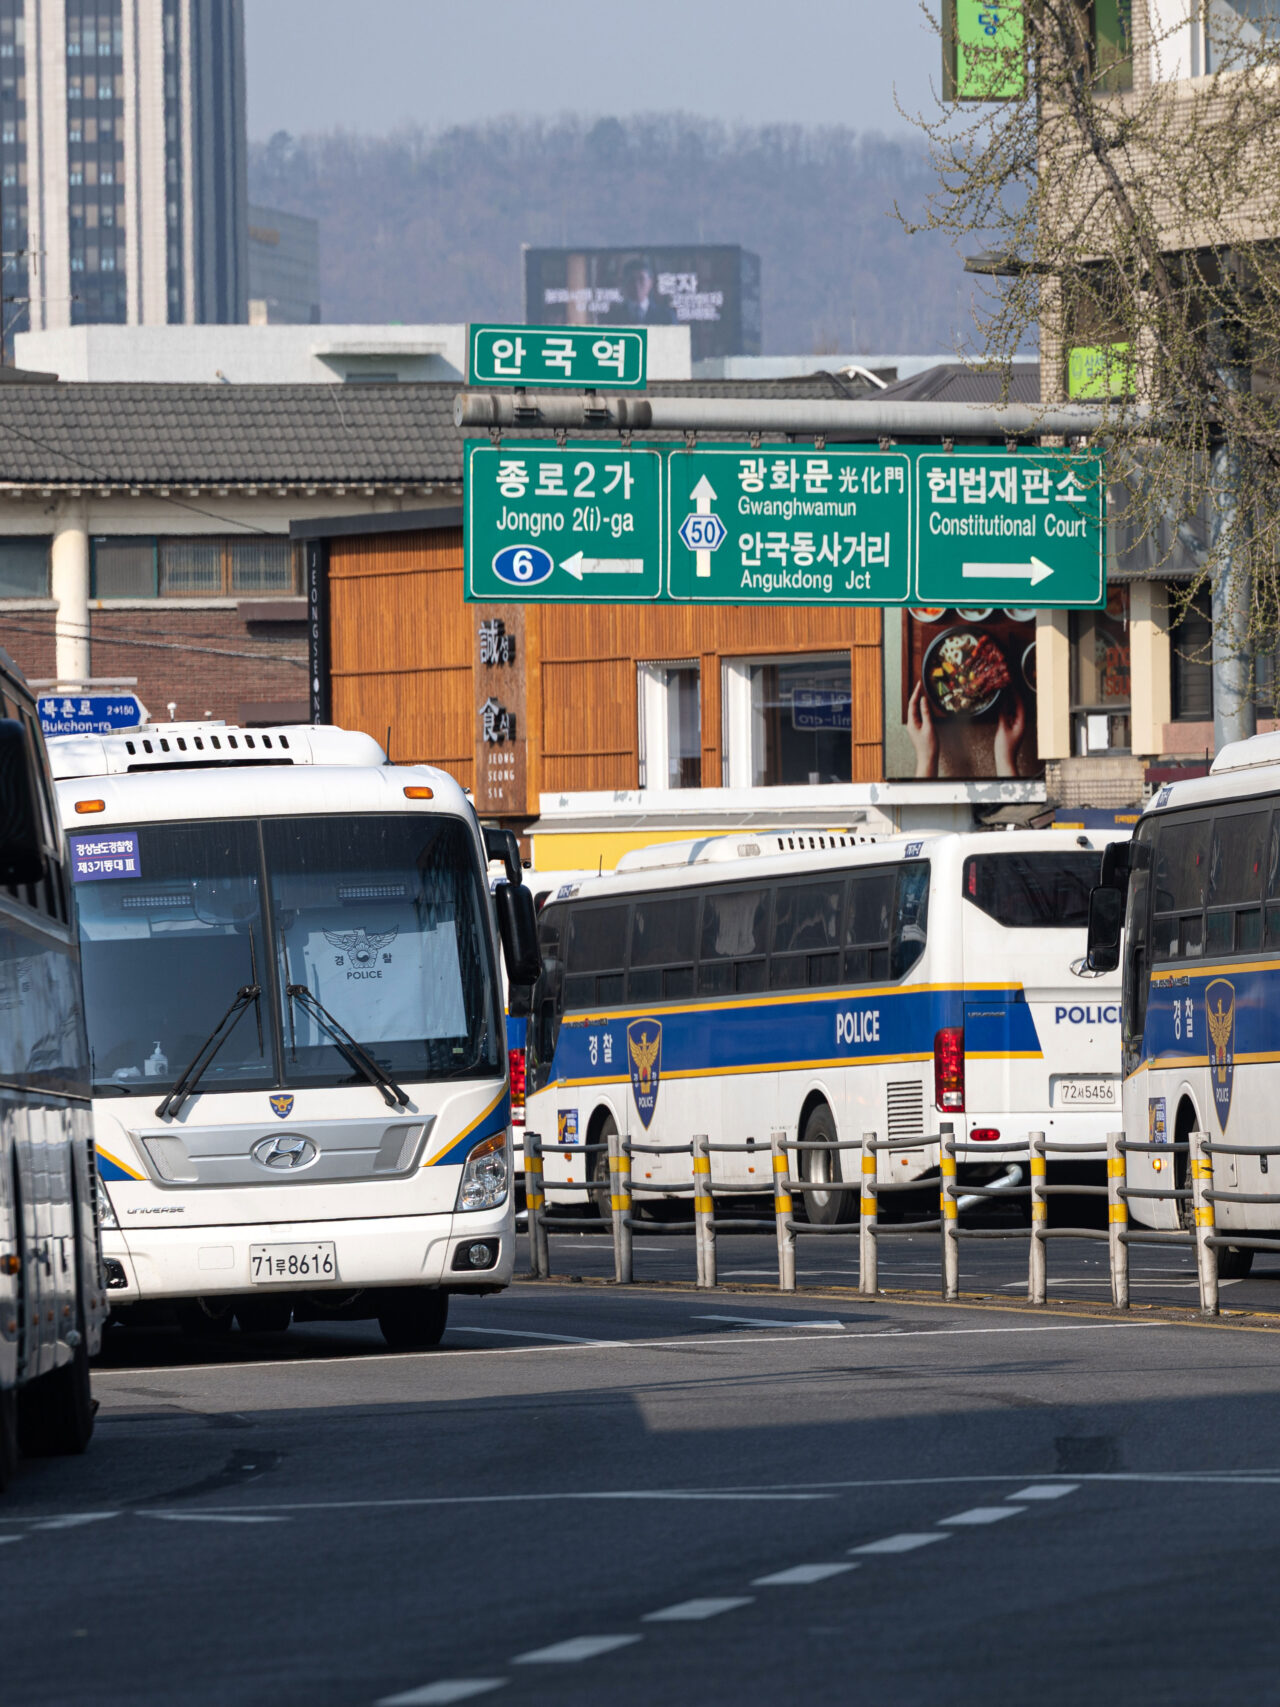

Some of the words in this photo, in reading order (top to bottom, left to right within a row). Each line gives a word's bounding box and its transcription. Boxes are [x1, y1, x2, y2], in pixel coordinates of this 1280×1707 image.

[491, 337, 626, 378] 안국역
[496, 460, 634, 499] 종로2가
[738, 457, 833, 493] 광화문
[838, 466, 904, 494] 光化門
[926, 466, 1087, 505] 헌법재판소
[738, 496, 857, 520] Gwanghwamun
[496, 506, 565, 537] Jongno
[572, 507, 634, 538] 2(i)-ga
[691, 521, 716, 544] 50
[929, 511, 1036, 537] Constitutional
[1044, 513, 1087, 538] Court
[738, 531, 890, 568] 안국동사거리
[512, 551, 534, 580] 6
[740, 569, 833, 593] Angukdong
[845, 571, 871, 590] Jct
[42, 699, 94, 719] 북촌로
[42, 720, 112, 733] Bukchon-ro
[488, 753, 515, 765] JEONG
[488, 770, 515, 783] SEONG
[488, 788, 503, 799] SIK
[76, 840, 133, 856] 경상남도경찰청
[77, 860, 123, 874] 제3기동대
[334, 955, 345, 967] 경
[346, 970, 383, 980] POLICE
[836, 1009, 880, 1045] POLICE
[1055, 1006, 1122, 1025] POLIC
[1173, 997, 1194, 1040] 경찰
[589, 1032, 613, 1066] 경찰
[638, 1096, 655, 1109] POLICE
[1062, 1084, 1114, 1100] 72서5456
[1215, 1087, 1230, 1103] POLICE
[127, 1206, 187, 1215] UNIVERSE
[252, 1253, 334, 1277] 71루8616
